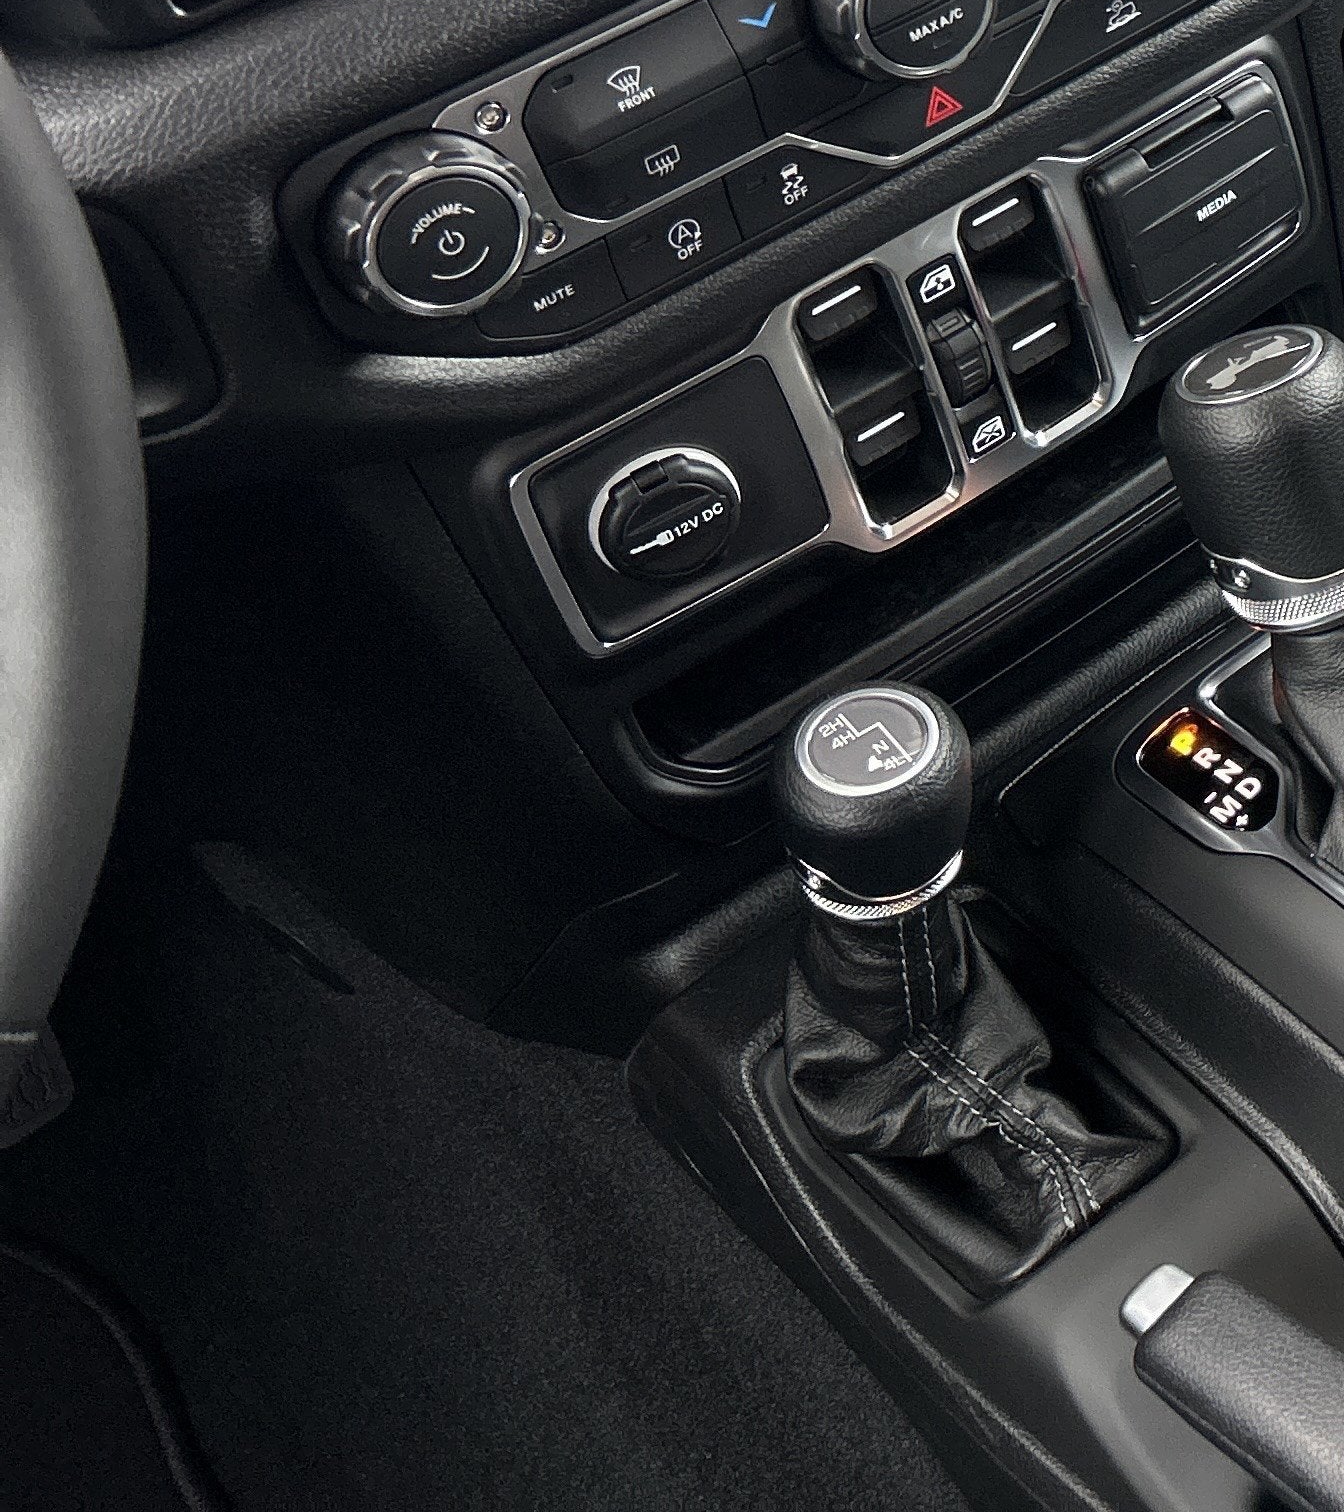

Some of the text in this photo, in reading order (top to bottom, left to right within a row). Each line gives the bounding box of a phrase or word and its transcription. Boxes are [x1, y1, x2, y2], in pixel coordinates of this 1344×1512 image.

[909, 7, 964, 42] MAX A/C
[617, 86, 656, 112] FRONT
[784, 186, 809, 206] OFF
[1196, 189, 1238, 222] MEDIA
[411, 202, 463, 236] VOLUME
[677, 238, 703, 261] OFF
[533, 283, 576, 313] MUTE
[673, 502, 725, 539] 12V DC
[818, 717, 845, 738] 2H
[832, 730, 857, 750] 4H
[872, 739, 890, 755] N
[1192, 747, 1222, 770] R
[1213, 758, 1244, 785] N
[1234, 776, 1262, 800] D
[1209, 794, 1243, 824] M
